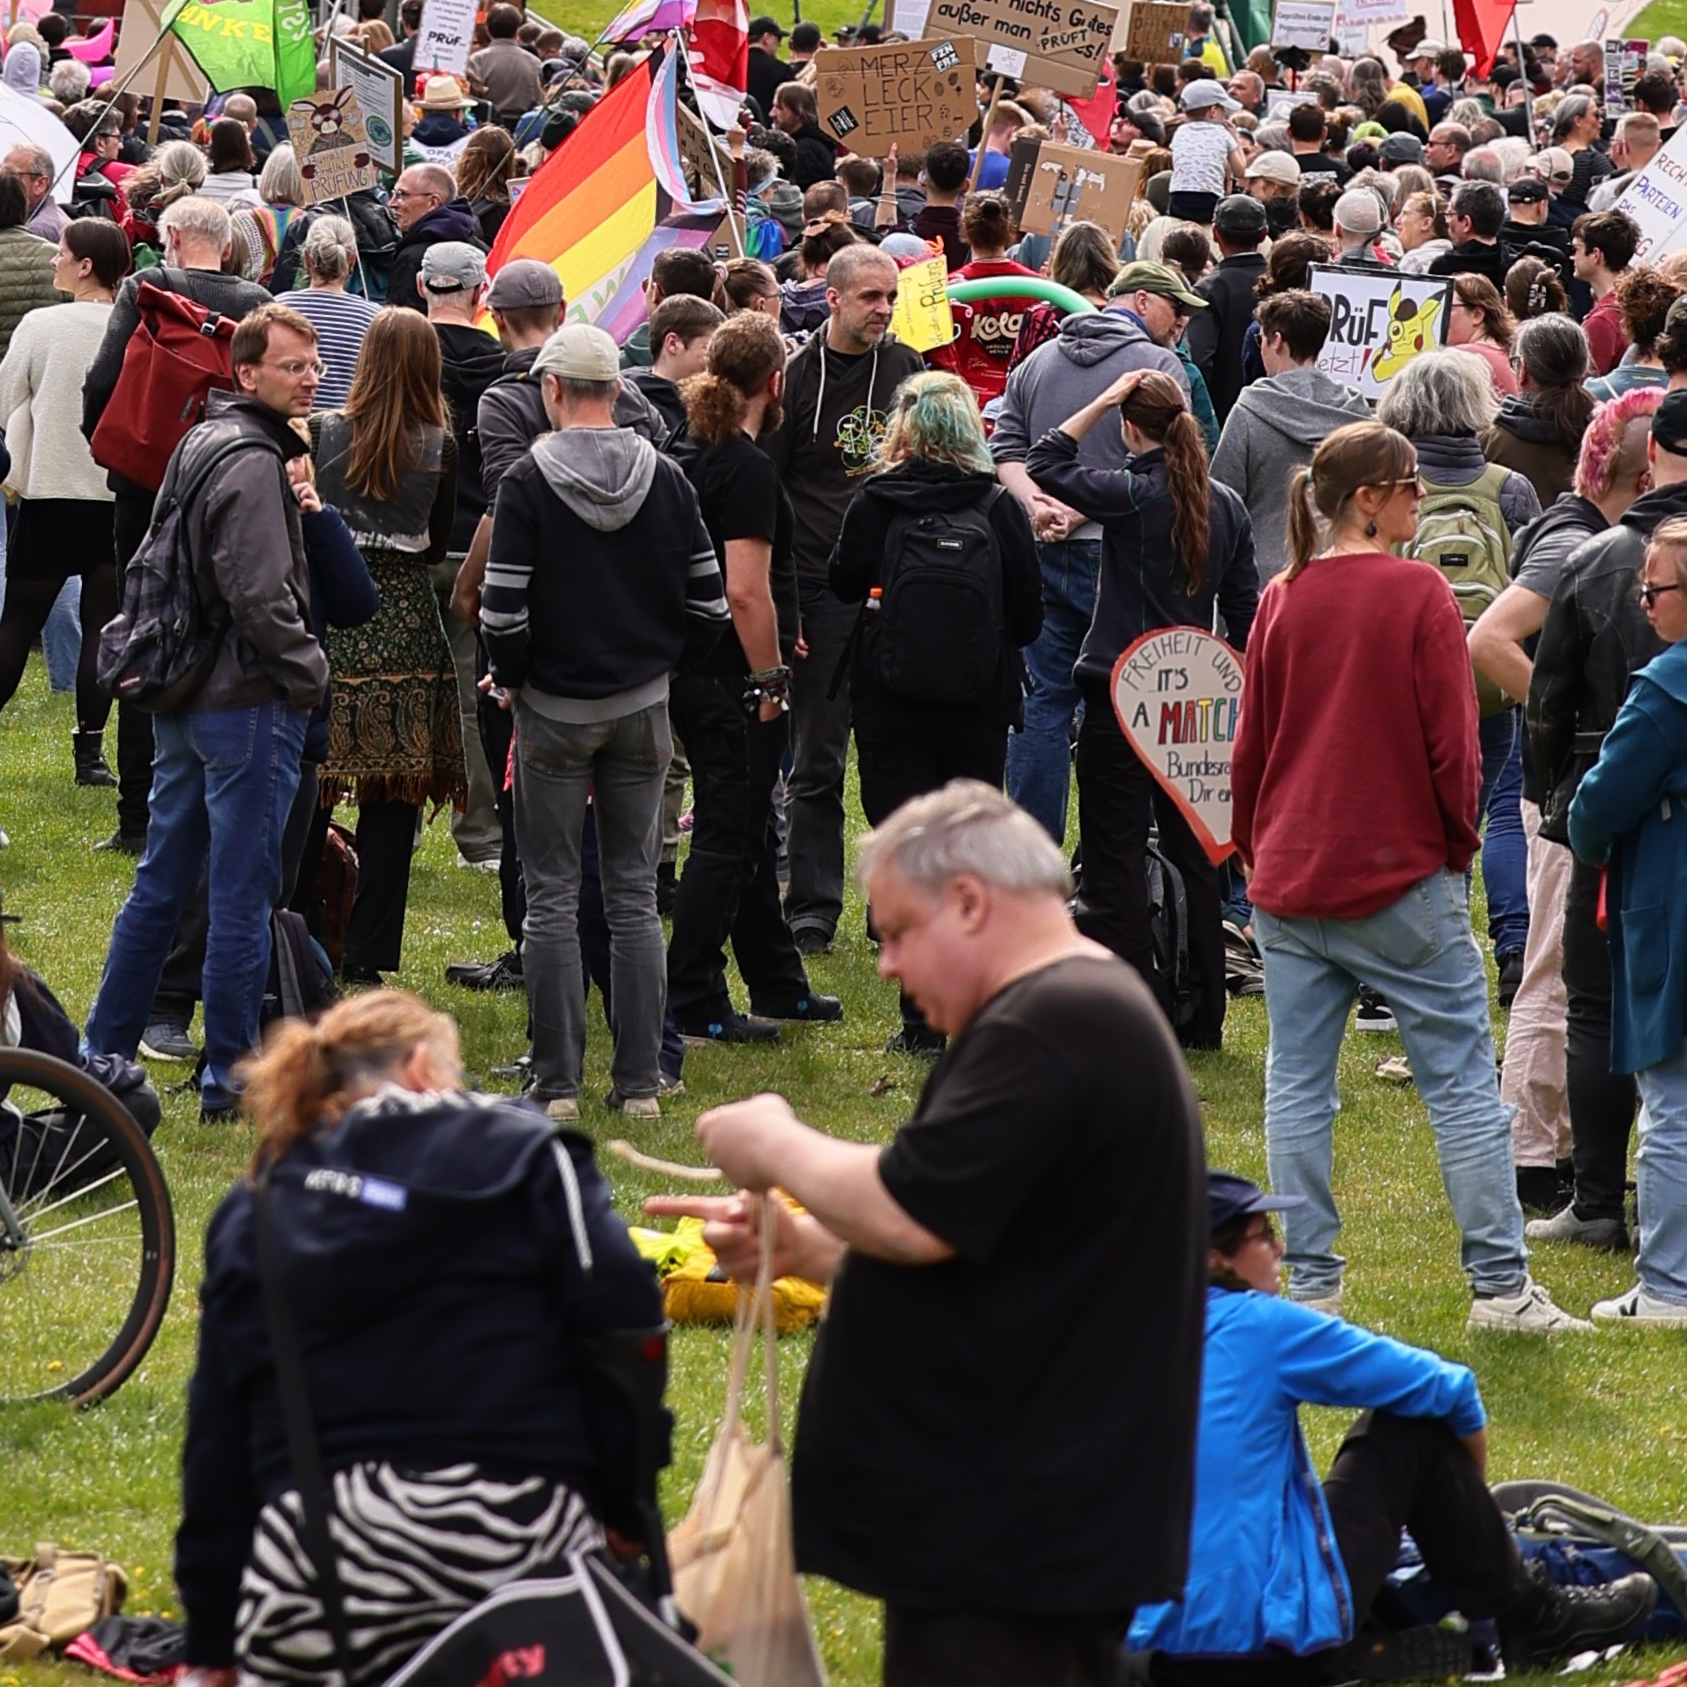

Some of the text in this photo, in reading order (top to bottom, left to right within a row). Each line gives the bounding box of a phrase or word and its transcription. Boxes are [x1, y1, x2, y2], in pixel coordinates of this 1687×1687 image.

[937, 2, 991, 27] außer
[993, 19, 1033, 41] man
[1038, 28, 1090, 51] PRÜFT
[1068, 7, 1114, 37] Gutes
[860, 50, 931, 79] MERZ
[863, 75, 932, 107] LECK
[864, 104, 933, 136] EIER
[1631, 175, 1684, 221] PARTEIEN
[1121, 632, 1242, 693] FREIHEIT UND
[1156, 667, 1189, 693] IT'S
[1131, 701, 1151, 729] A
